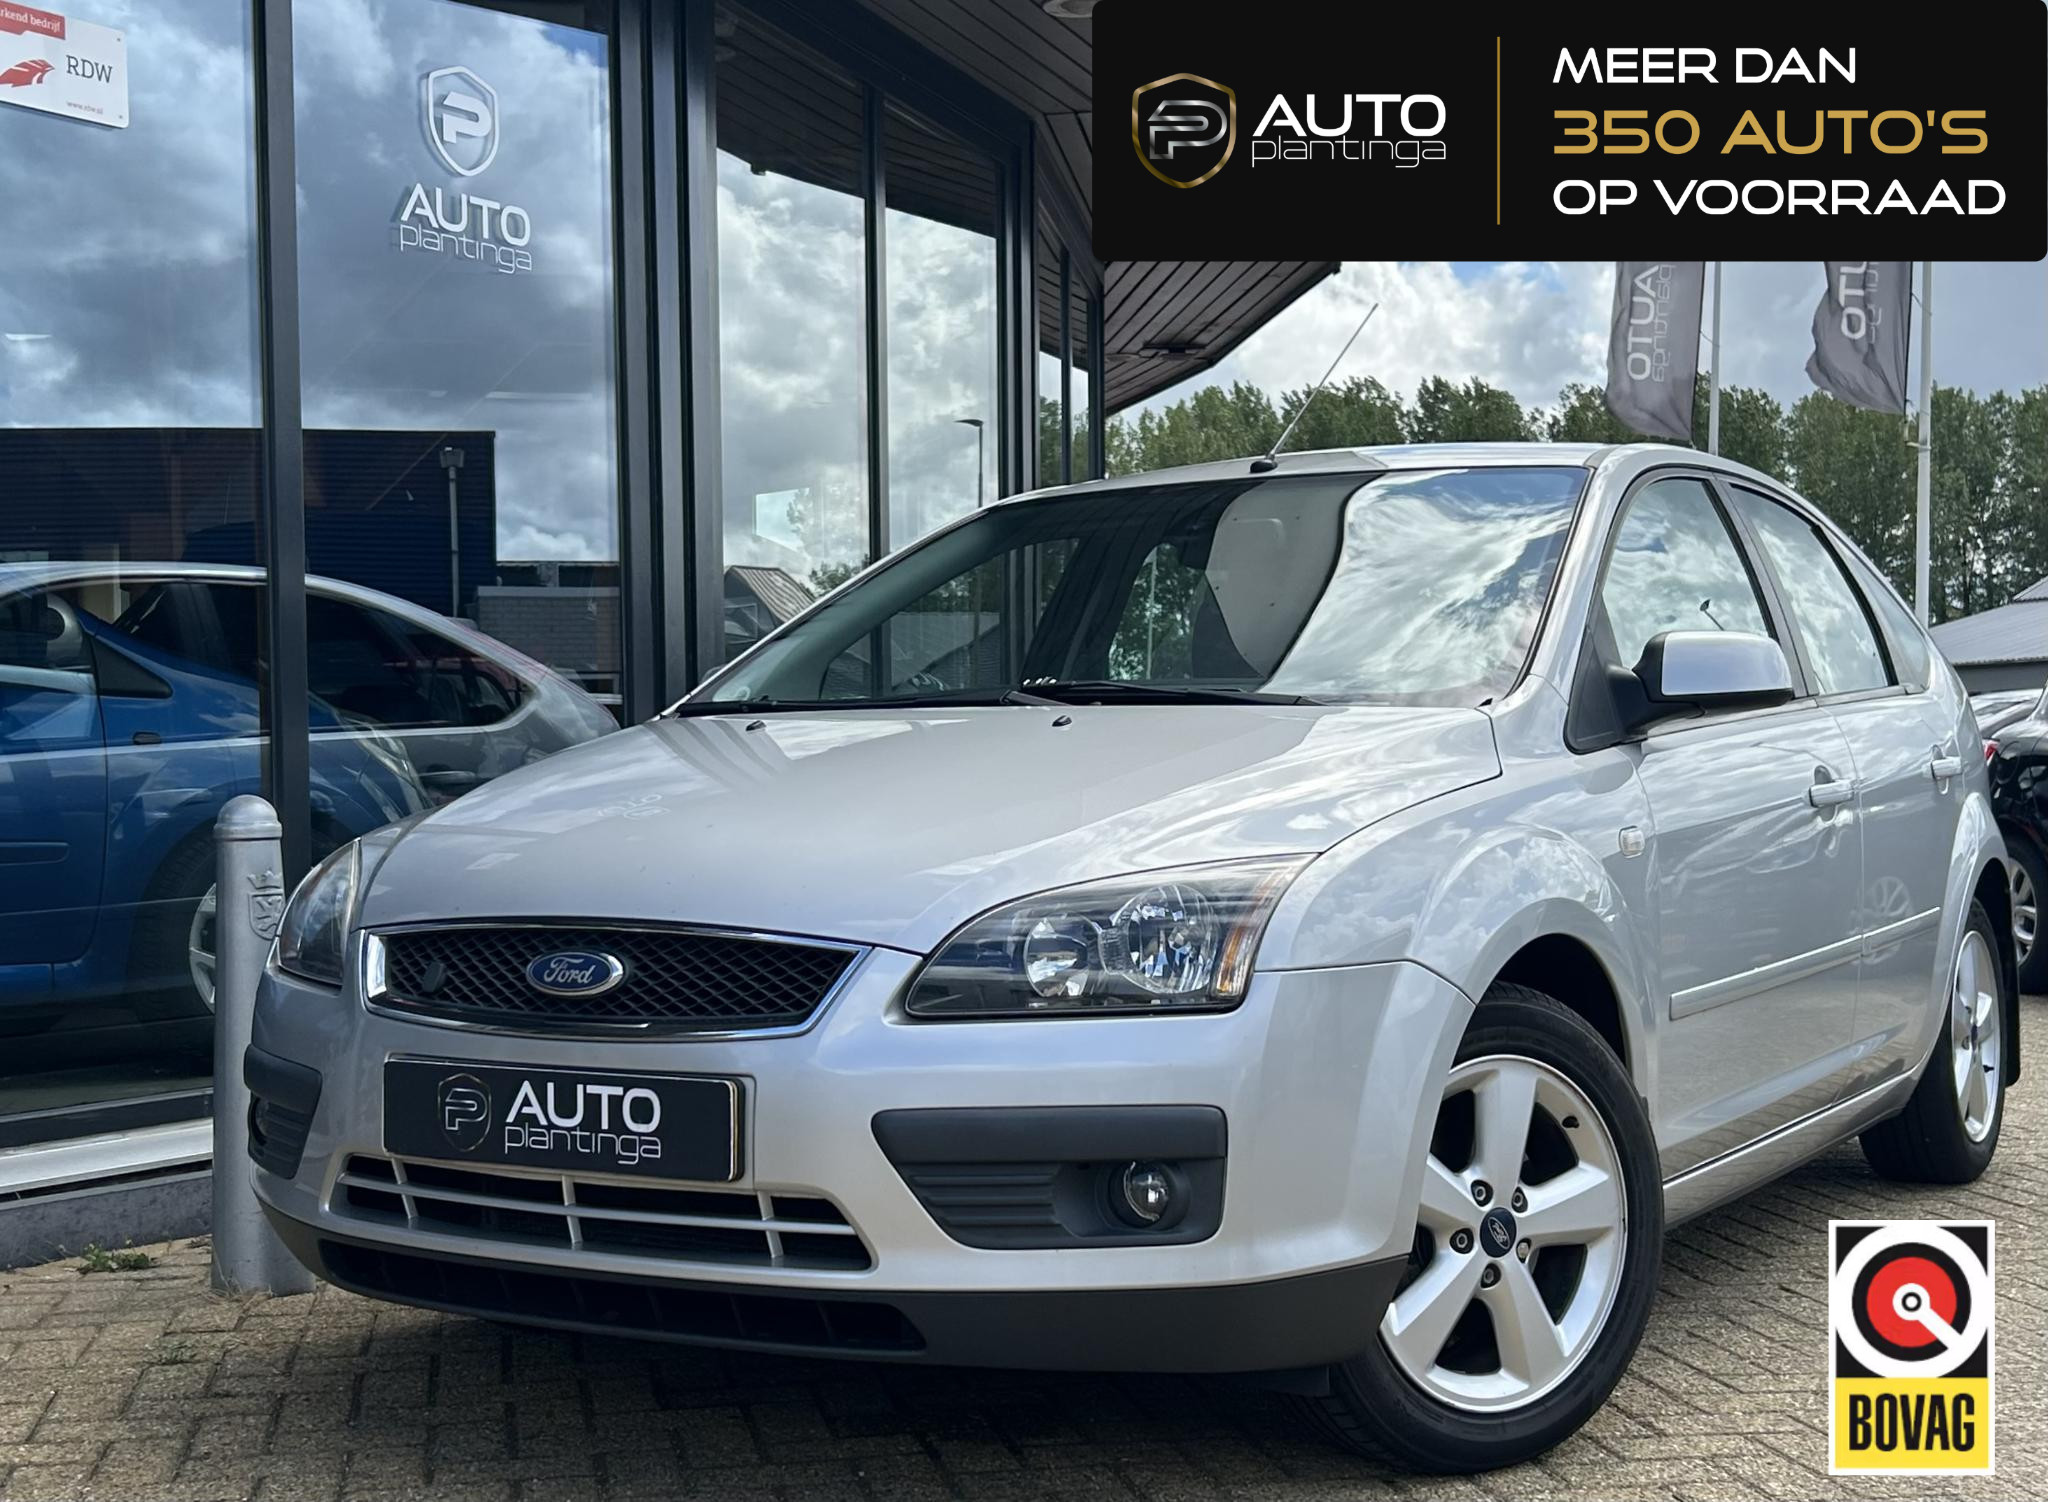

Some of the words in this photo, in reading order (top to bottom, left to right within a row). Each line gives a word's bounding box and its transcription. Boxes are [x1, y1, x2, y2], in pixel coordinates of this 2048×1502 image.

[0, 8, 28, 24] rkend
[66, 54, 113, 83] RDW
[401, 183, 531, 247] AUTO
[400, 223, 532, 274] plantinga
[543, 956, 596, 984] Ford
[506, 1080, 661, 1133] AUTO
[505, 1122, 661, 1165] plantinga
